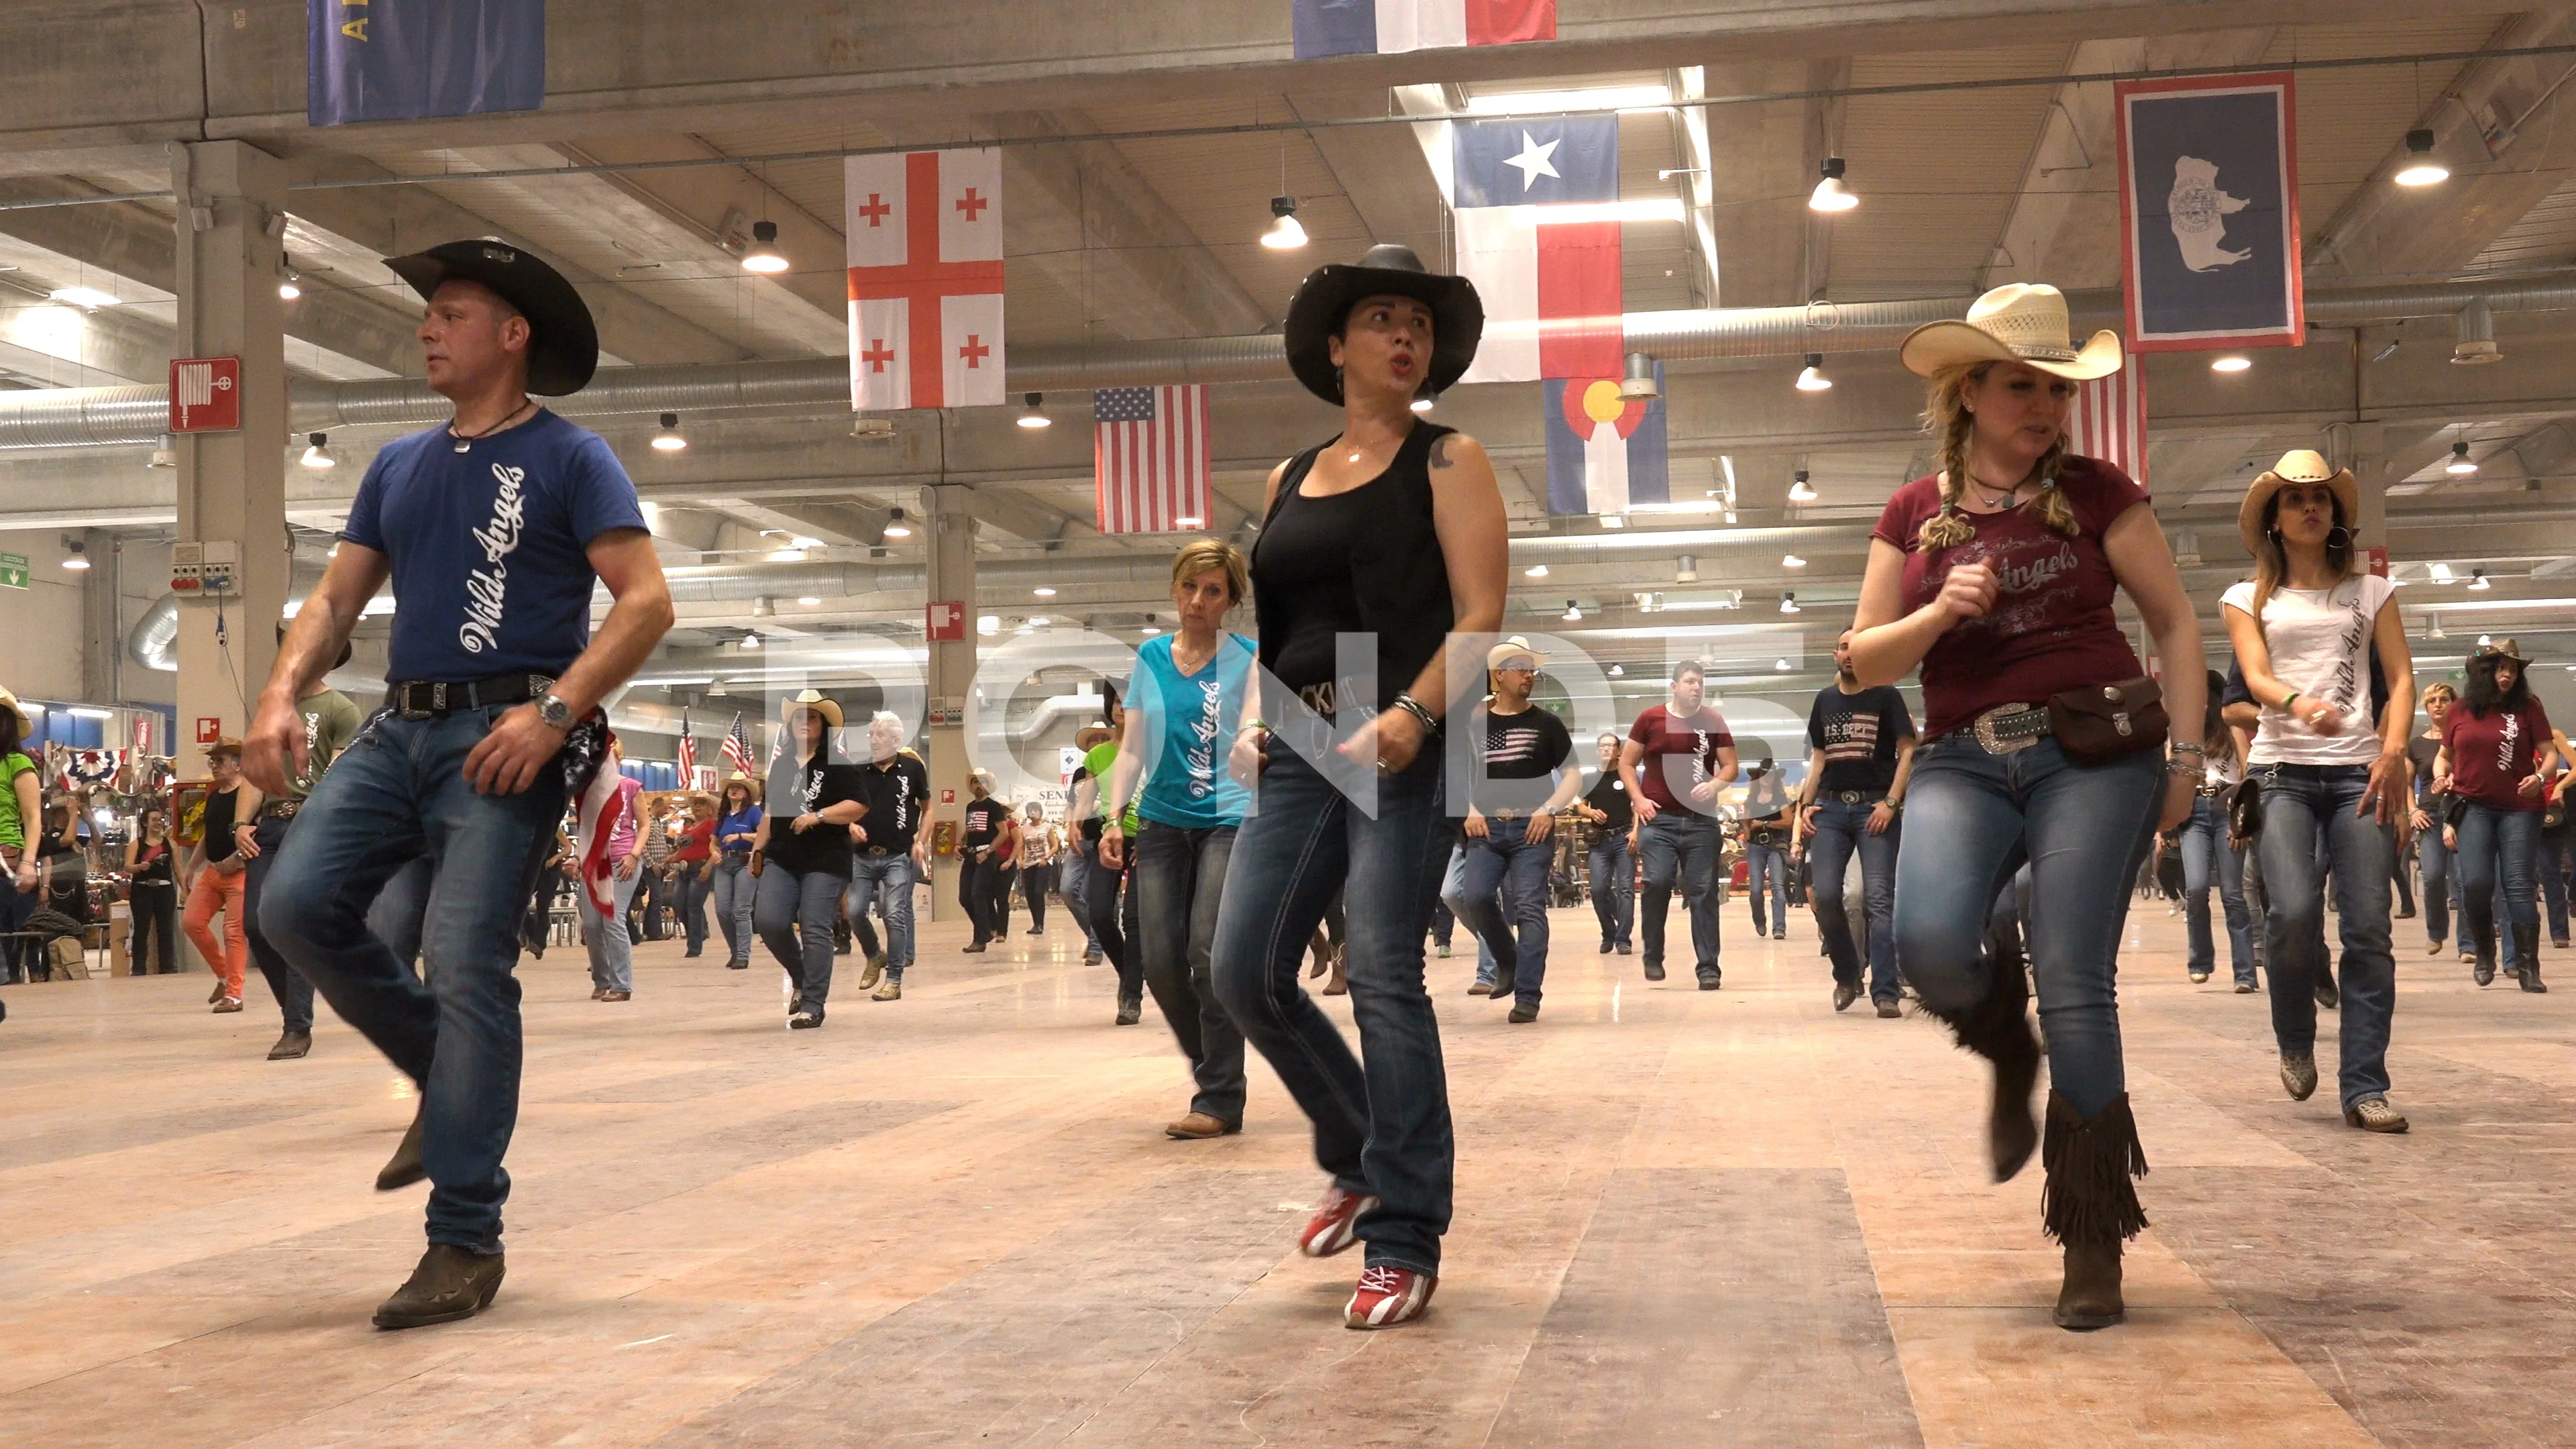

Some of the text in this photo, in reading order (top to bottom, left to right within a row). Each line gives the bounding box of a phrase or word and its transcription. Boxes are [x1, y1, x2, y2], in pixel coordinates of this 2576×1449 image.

[460, 463, 526, 653] Wild Angels
[1998, 541, 2078, 594] Angels
[2335, 660, 2355, 714] Wild
[1187, 680, 1222, 797] Wild Angels
[2498, 713, 2519, 771] Wild Angels
[802, 769, 824, 807] Angels
